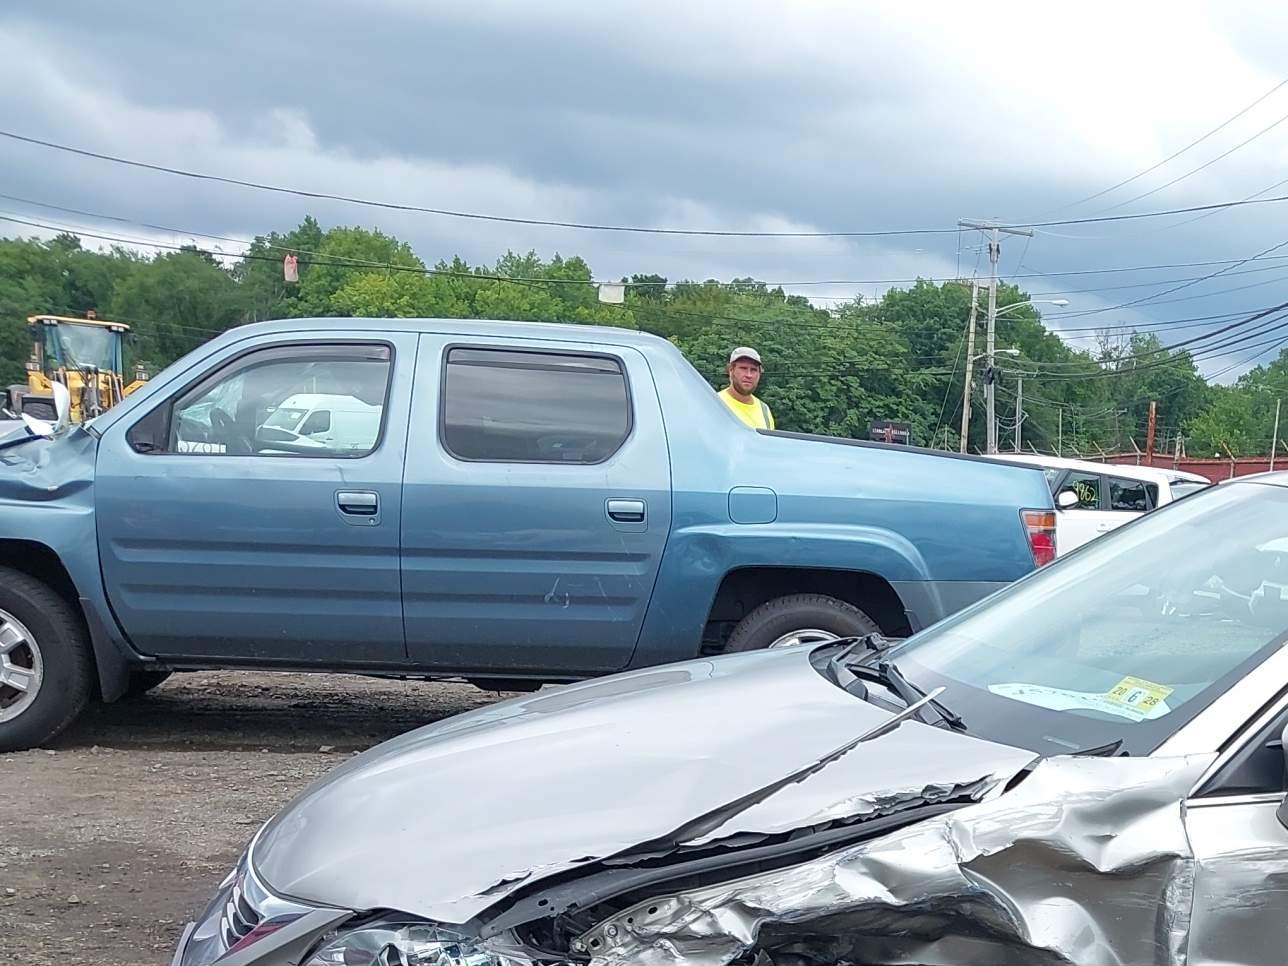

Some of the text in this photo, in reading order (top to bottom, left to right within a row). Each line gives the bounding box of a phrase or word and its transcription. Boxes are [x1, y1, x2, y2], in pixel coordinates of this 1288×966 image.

[1112, 686, 1127, 696] 20
[1127, 690, 1142, 702] 6
[1143, 696, 1159, 706] 28
